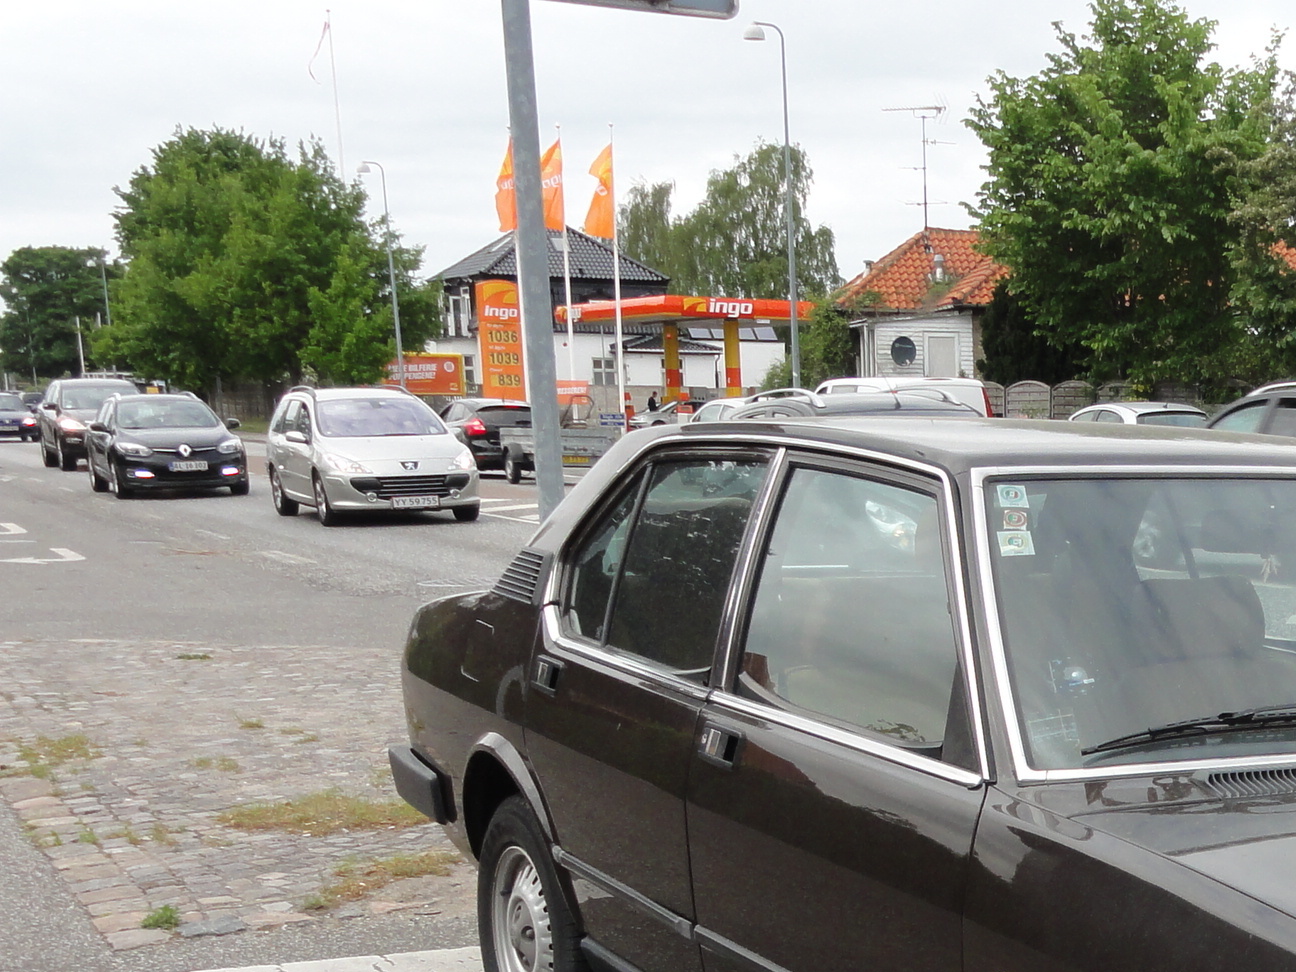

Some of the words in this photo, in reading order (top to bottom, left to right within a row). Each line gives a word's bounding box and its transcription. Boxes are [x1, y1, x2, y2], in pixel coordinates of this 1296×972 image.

[484, 305, 518, 320] ingo
[709, 299, 753, 318] ingo
[489, 331, 518, 343] 1036
[490, 353, 519, 365] 1039
[498, 374, 521, 386] 839
